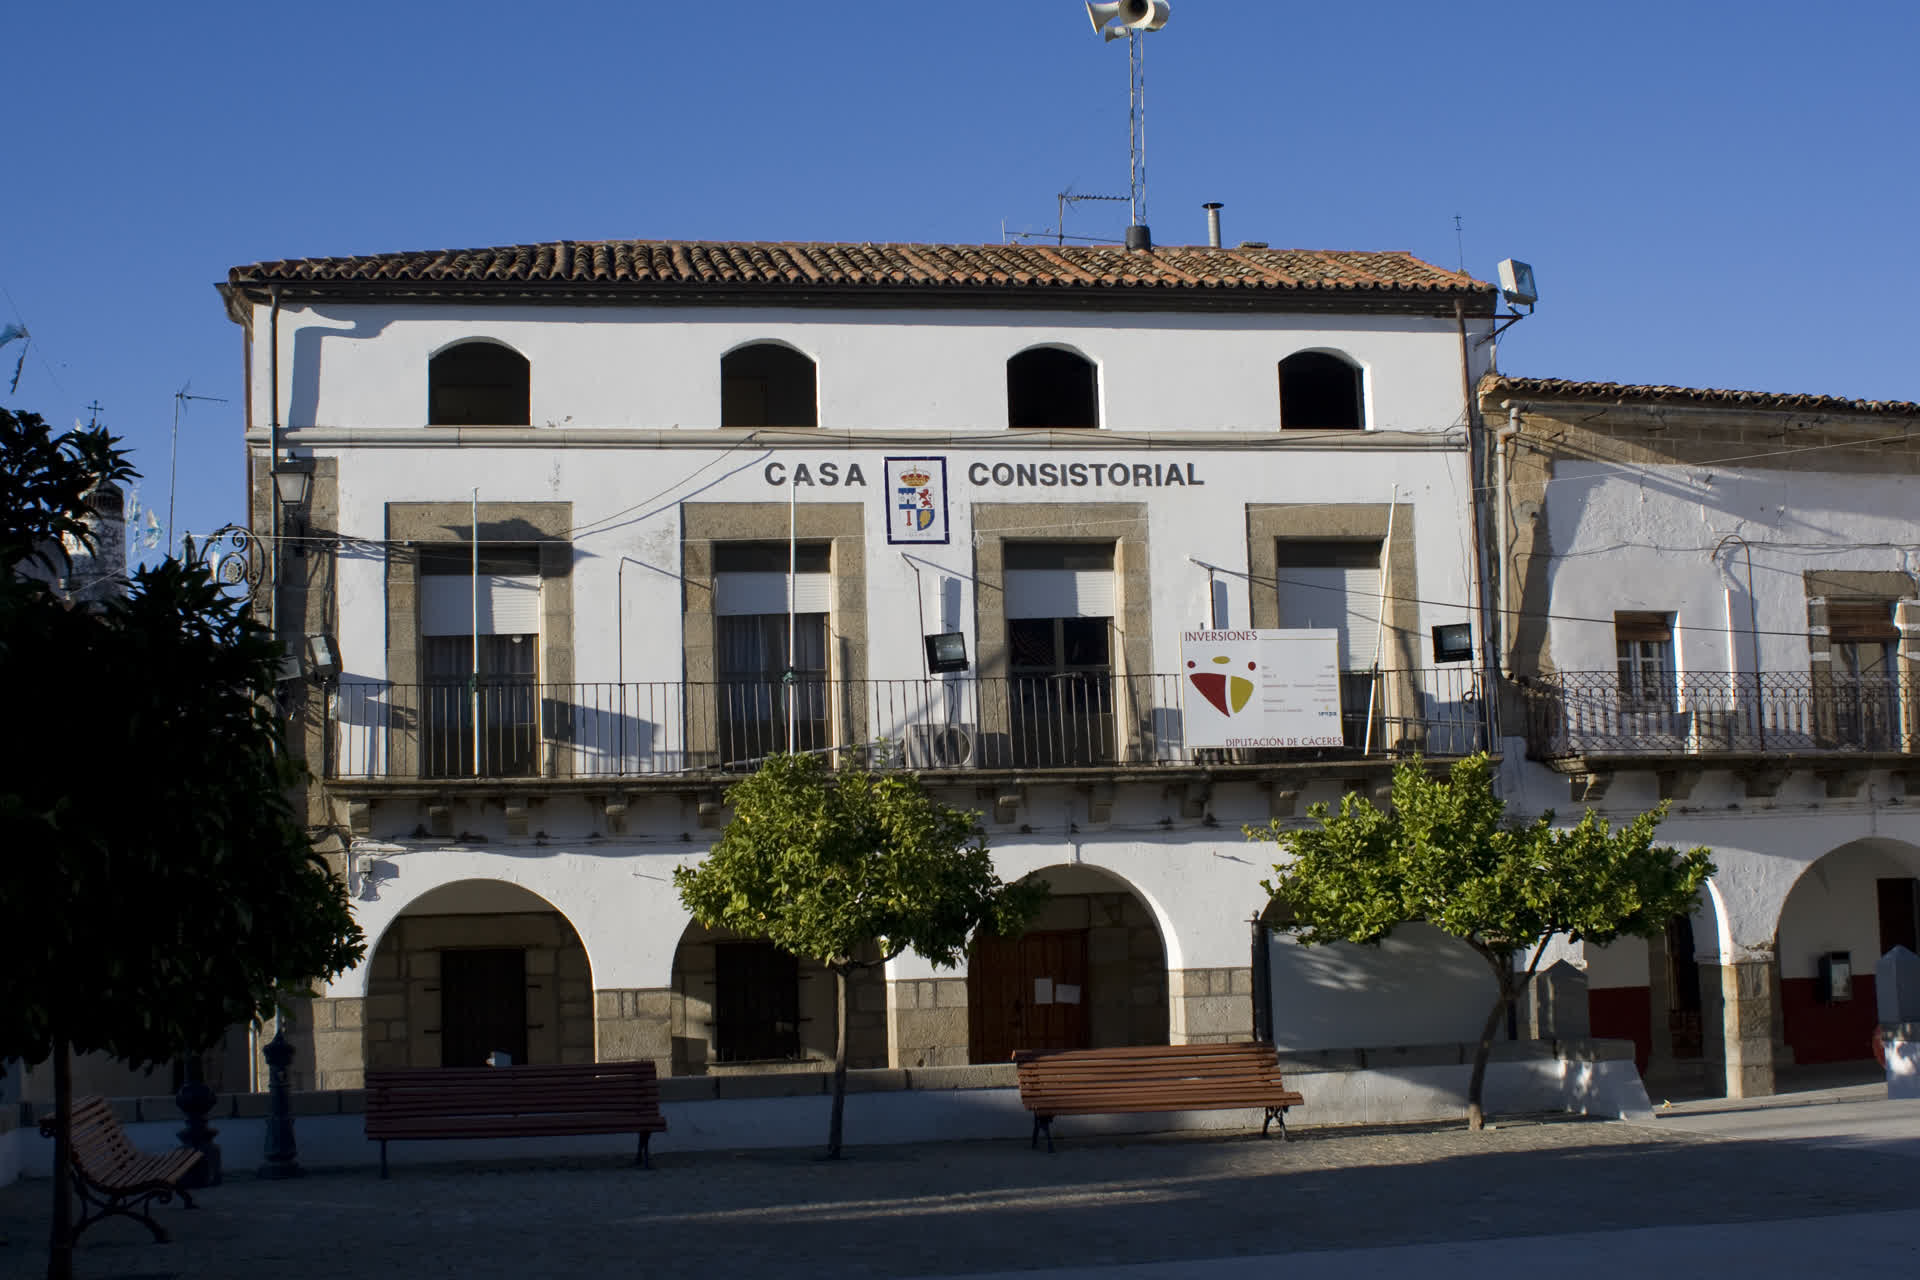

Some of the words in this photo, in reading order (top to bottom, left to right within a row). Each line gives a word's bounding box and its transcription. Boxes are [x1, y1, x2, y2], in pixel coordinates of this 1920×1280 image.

[764, 462, 867, 487] CASA
[968, 462, 1205, 487] CONSISTORIAL
[1185, 631, 1258, 641] INVERSIONES
[1225, 736, 1284, 746] DIPUTACIÓN
[1287, 737, 1298, 746] DE
